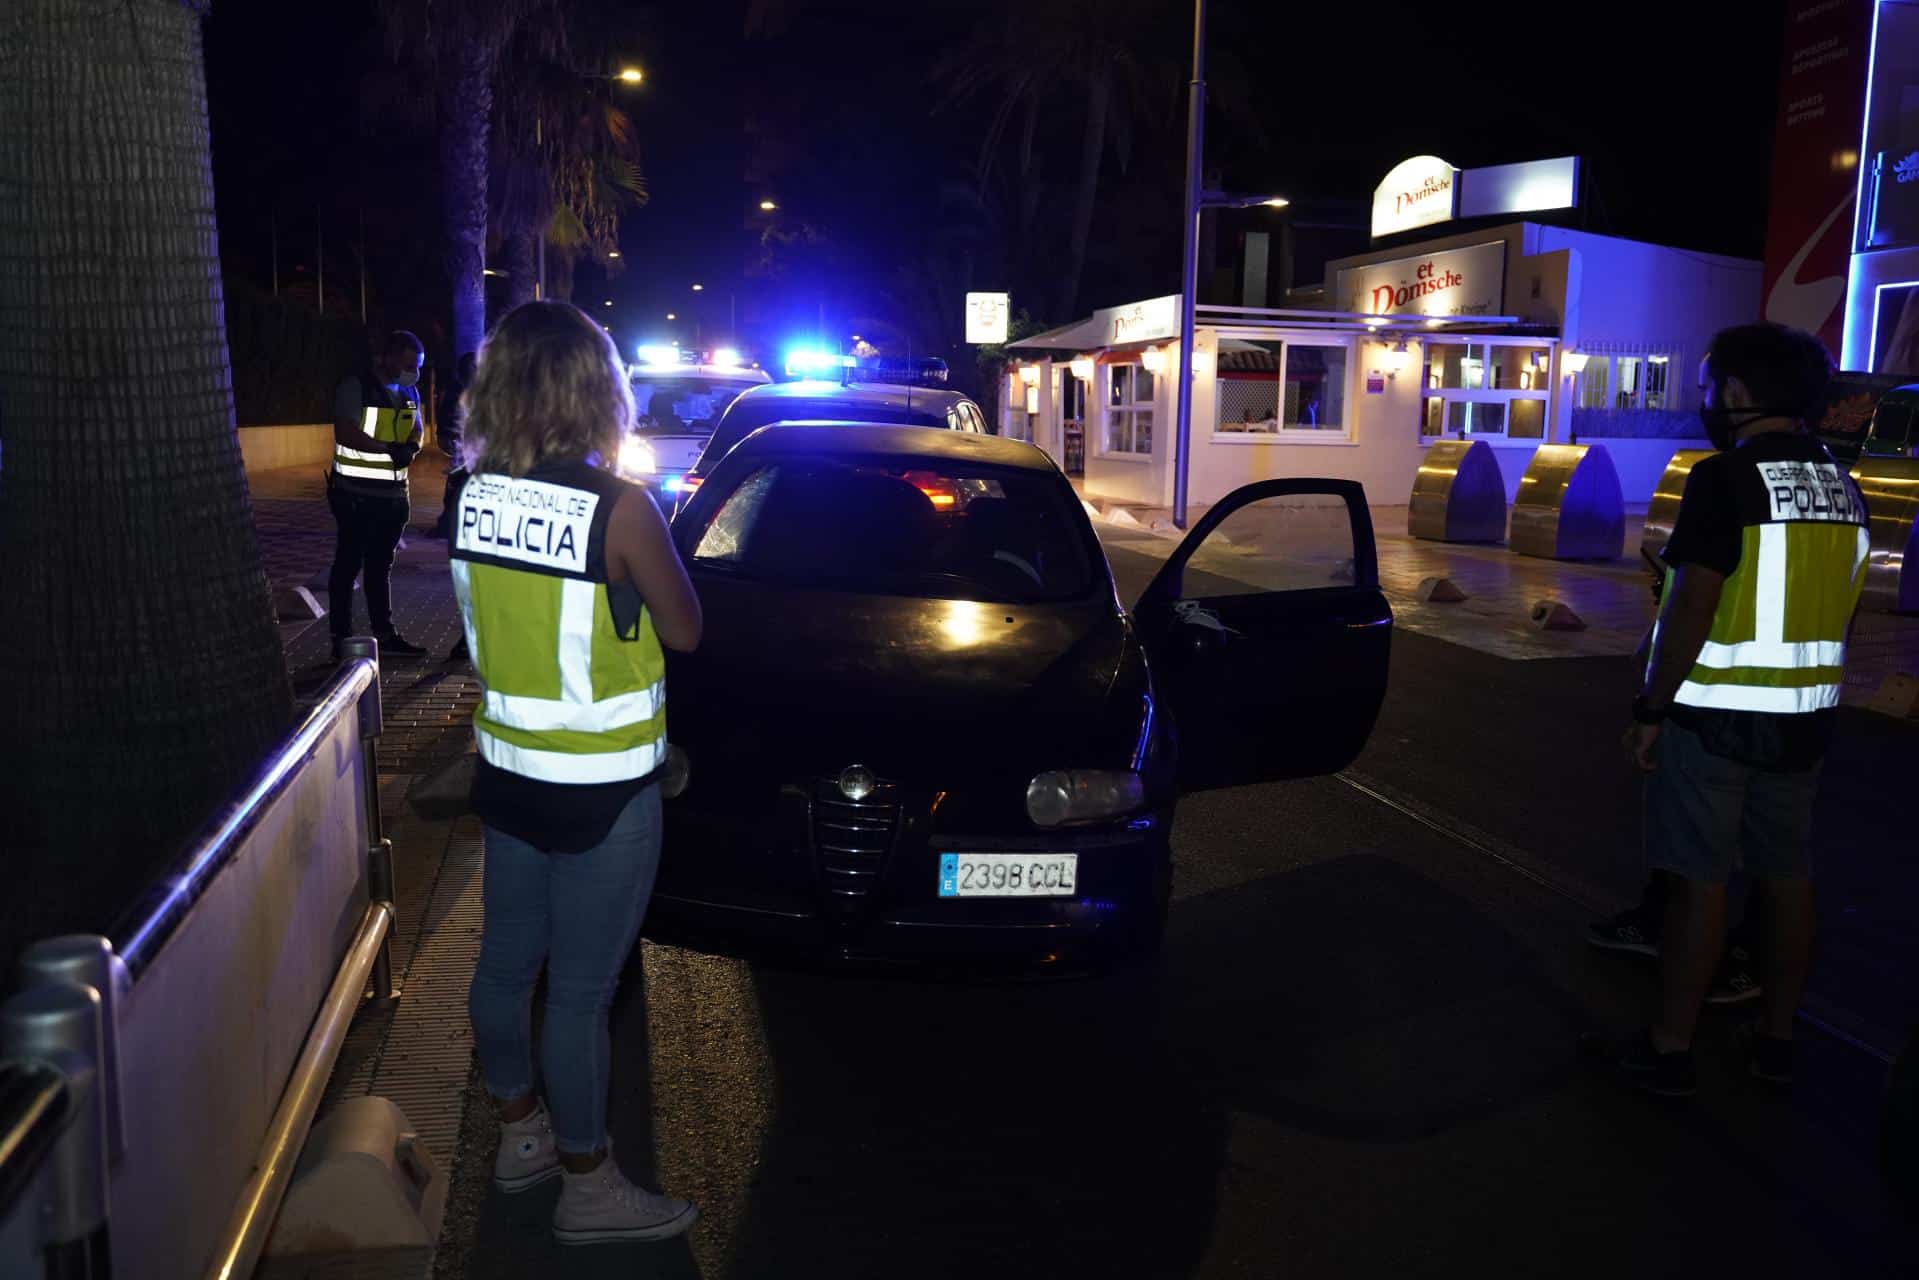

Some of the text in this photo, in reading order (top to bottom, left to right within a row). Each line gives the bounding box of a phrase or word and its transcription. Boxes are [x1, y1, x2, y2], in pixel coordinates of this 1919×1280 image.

[1417, 261, 1434, 280] et
[1373, 270, 1462, 316] Dömsche
[566, 496, 589, 518] DE
[462, 506, 577, 561] POLICIA
[944, 879, 955, 891] E
[960, 861, 1073, 890] 2398 CCL
